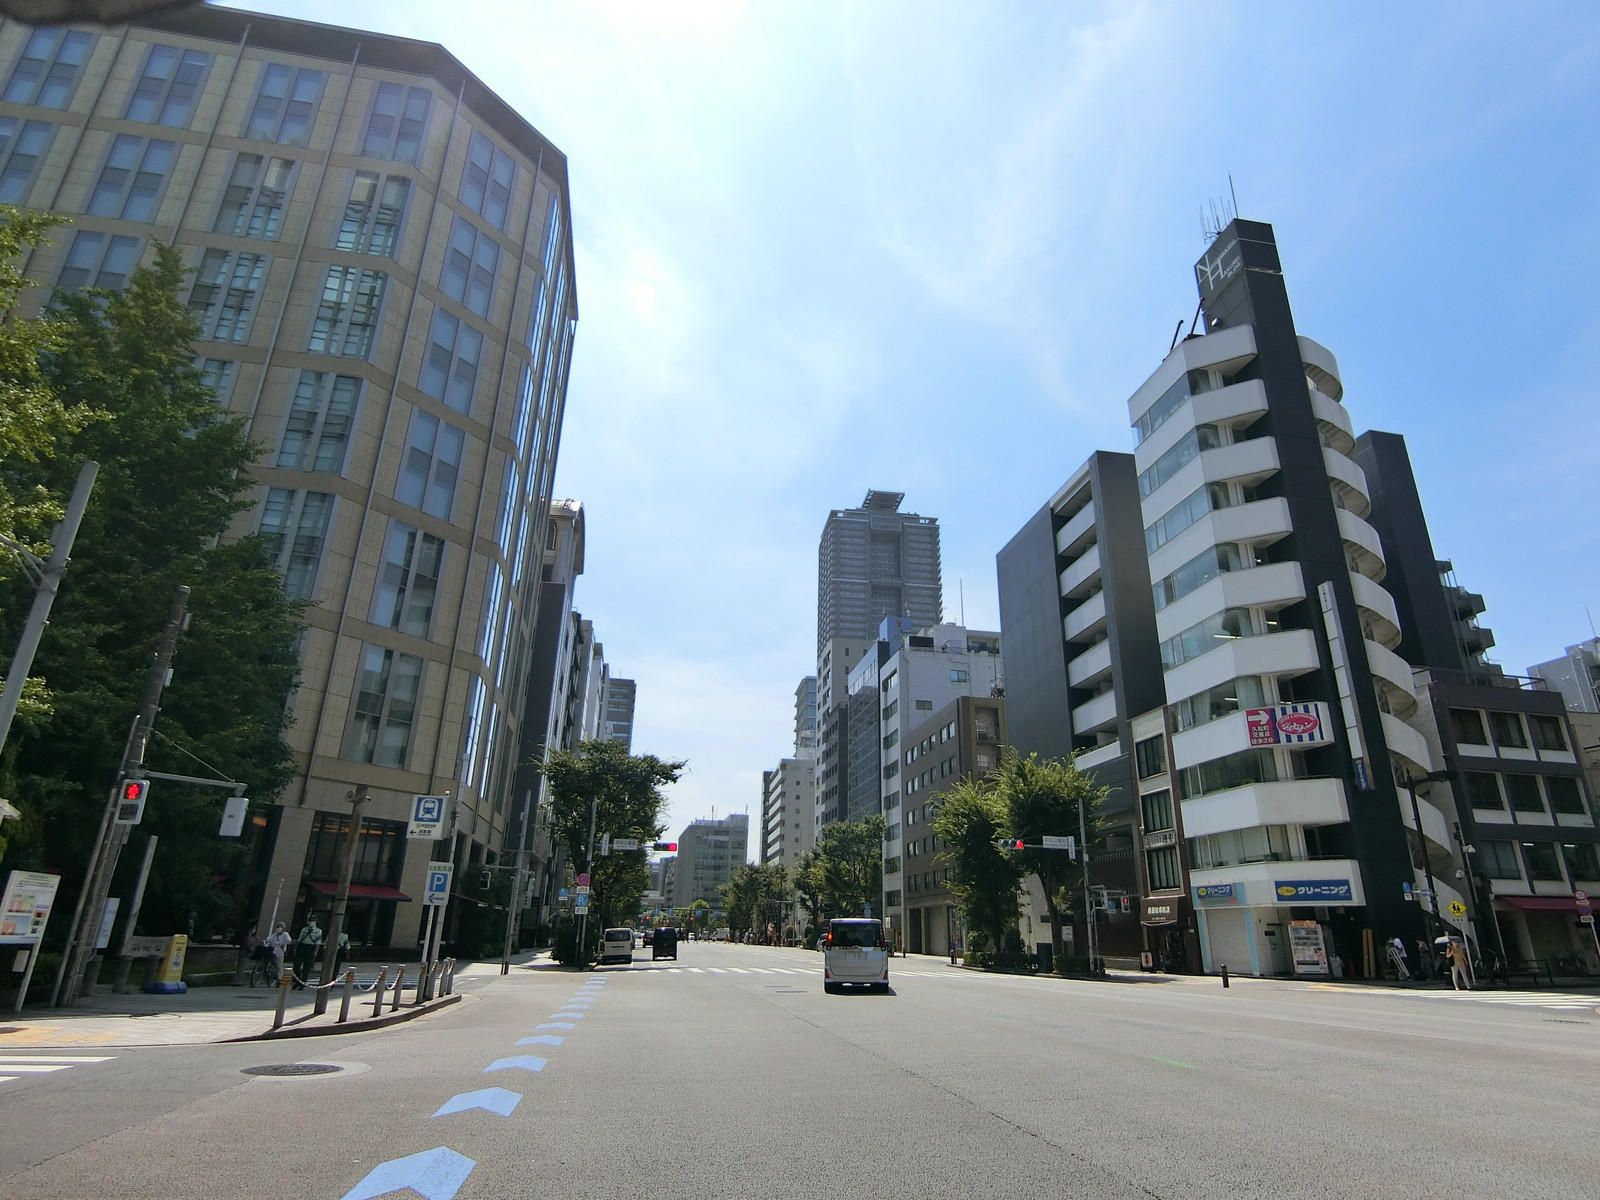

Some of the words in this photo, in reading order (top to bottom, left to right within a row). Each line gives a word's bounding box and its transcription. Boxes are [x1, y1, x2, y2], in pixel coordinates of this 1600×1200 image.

[433, 874, 444, 891] P
[1297, 884, 1348, 895] クリーニング
